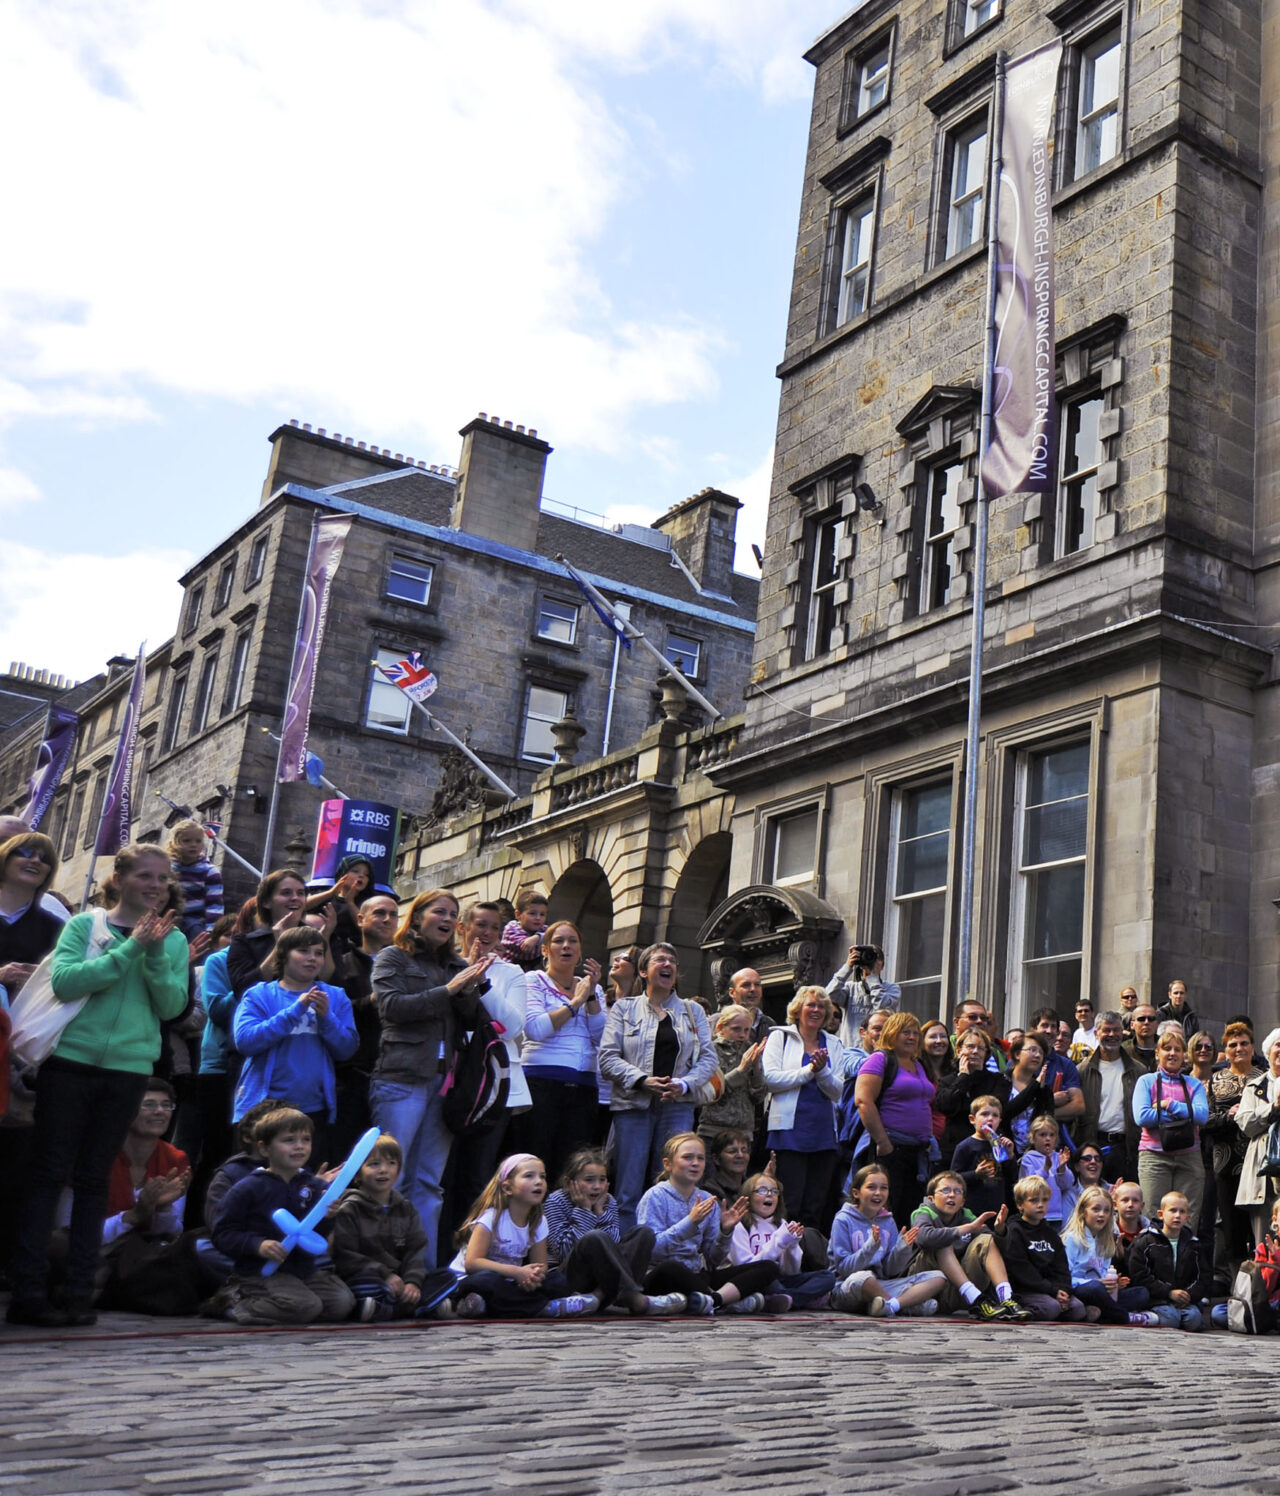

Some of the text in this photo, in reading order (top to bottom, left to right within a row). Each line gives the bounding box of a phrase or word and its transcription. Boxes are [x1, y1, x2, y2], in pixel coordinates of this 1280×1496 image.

[1029, 97, 1050, 480] WWW.EDINBURGH-INSPIRINGCAPITAL.COM
[365, 810, 391, 827] RBS
[345, 837, 386, 858] fringe
